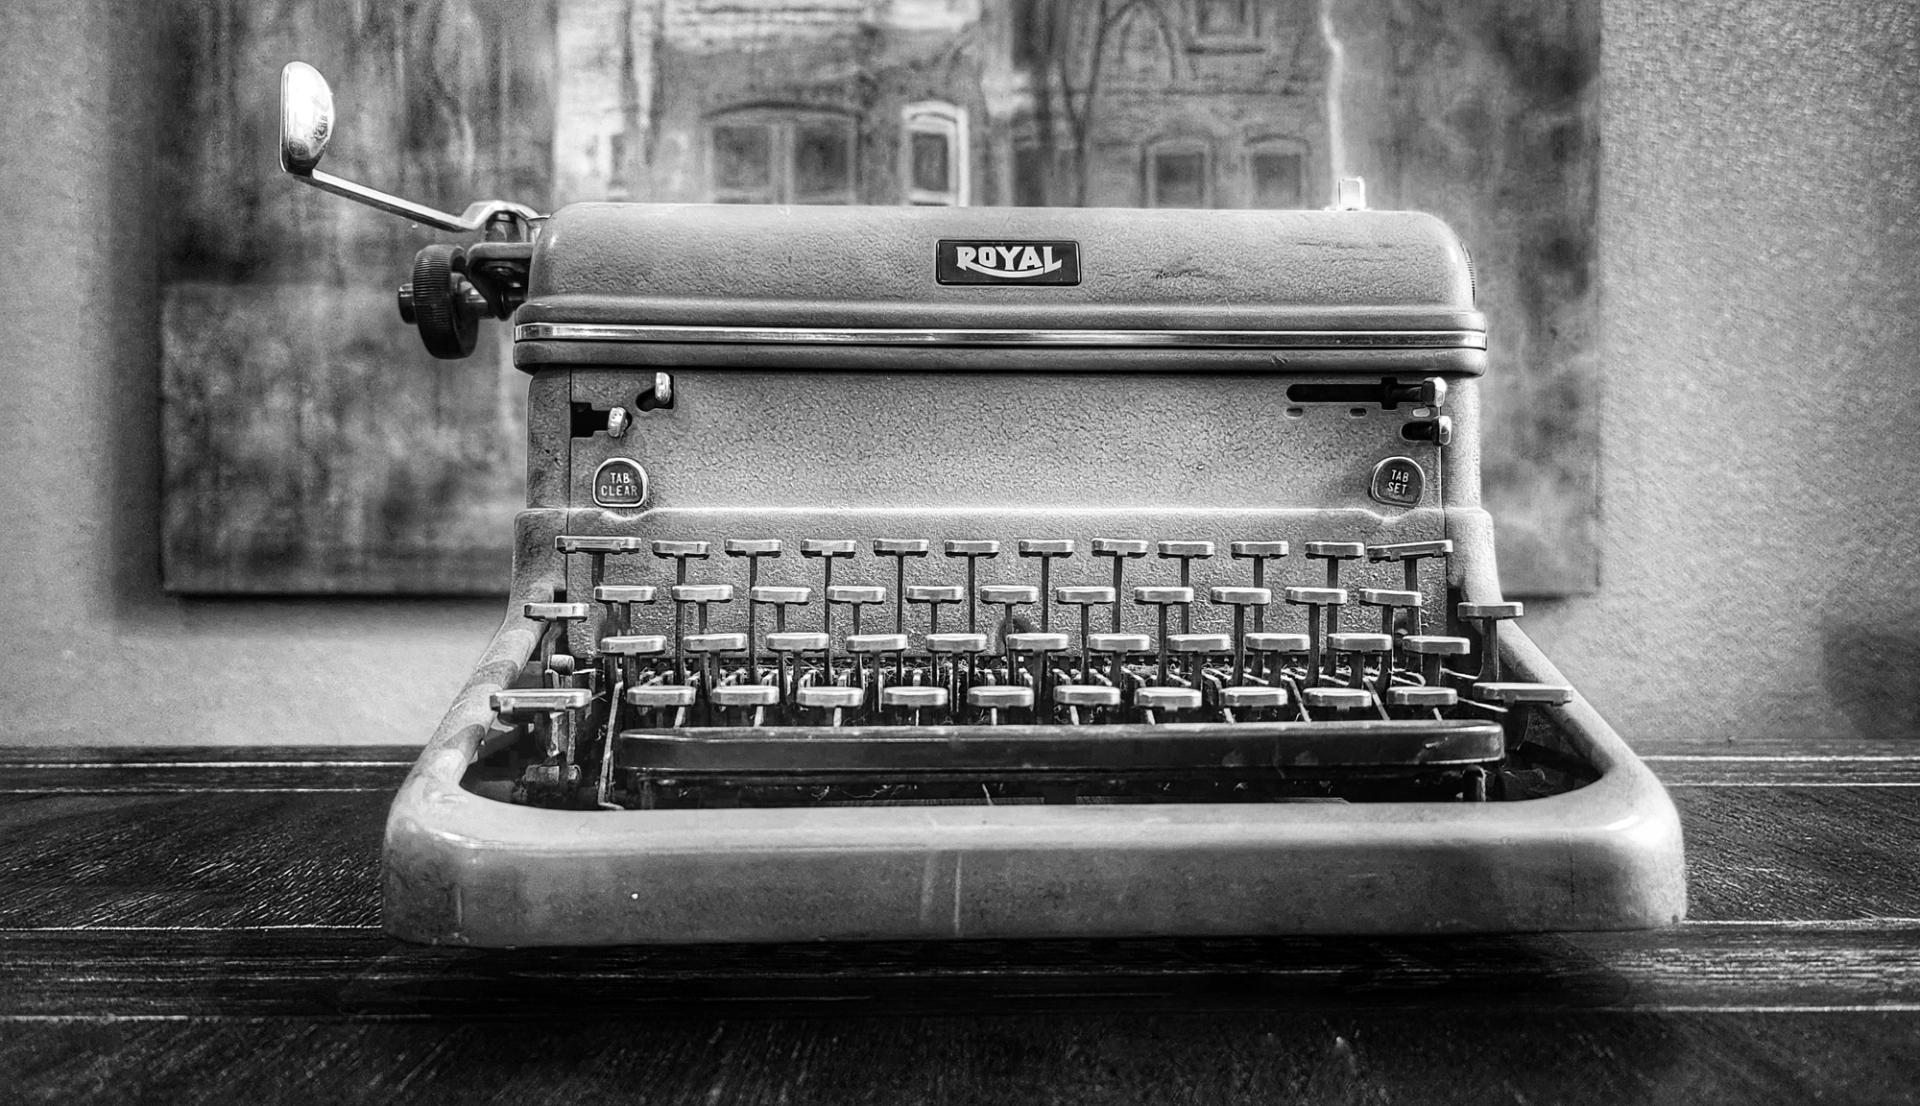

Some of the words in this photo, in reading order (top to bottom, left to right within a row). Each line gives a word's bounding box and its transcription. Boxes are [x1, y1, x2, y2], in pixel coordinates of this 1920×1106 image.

[956, 246, 1062, 278] ROYAL
[610, 472, 630, 484] TAB
[1391, 469, 1409, 483] TAB
[601, 485, 638, 497] CLEAR
[1387, 481, 1408, 495] SET
